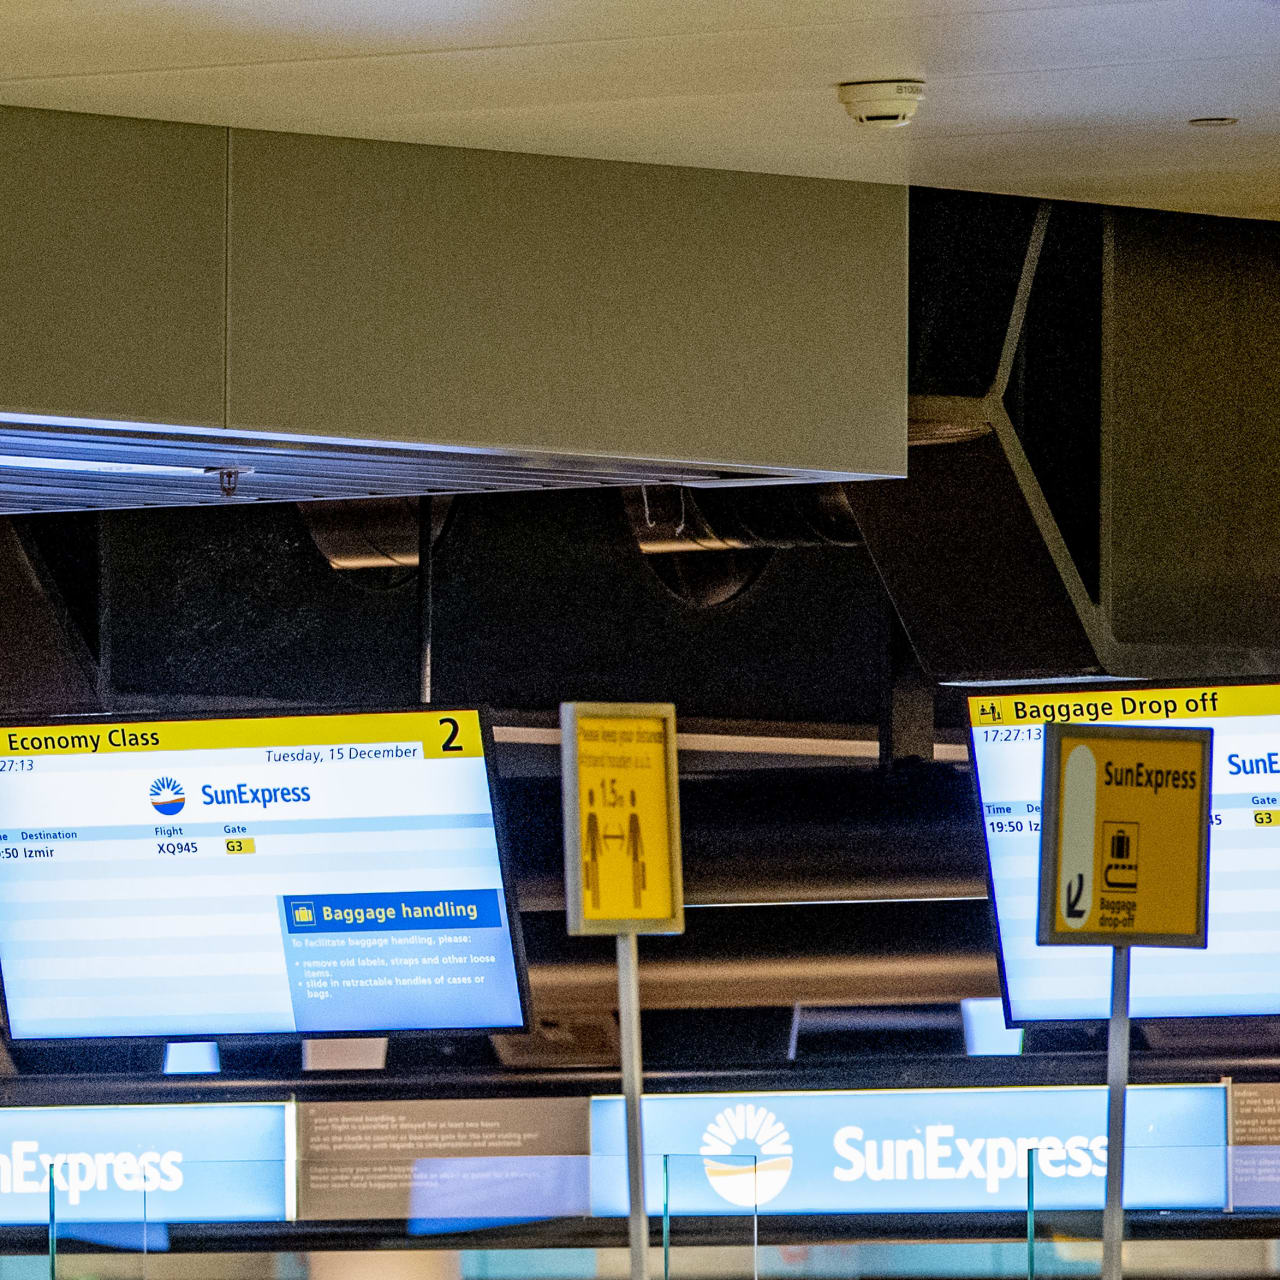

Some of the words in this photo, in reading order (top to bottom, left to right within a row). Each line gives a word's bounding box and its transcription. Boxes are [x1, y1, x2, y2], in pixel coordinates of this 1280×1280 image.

[1014, 700, 1113, 723] Baggage
[1121, 697, 1177, 718] Drop
[1185, 692, 1218, 713] off
[8, 732, 100, 752] Economy
[108, 728, 160, 747] Class
[439, 717, 463, 752] 2
[983, 728, 1042, 743] 17:27:13
[266, 749, 323, 763] Tuesday,
[329, 747, 344, 760] 15
[349, 746, 418, 760] December
[1104, 761, 1197, 795] SunExpress
[201, 783, 311, 809] SunExpress
[1251, 796, 1278, 805] Gate
[985, 804, 1012, 815] Time
[989, 820, 1023, 833] 19:50
[1254, 812, 1273, 825] G3
[21, 830, 77, 841] Destination
[154, 826, 183, 837] Flight
[223, 824, 247, 834] Gate
[23, 847, 54, 858] Izmir
[157, 842, 198, 855] XQ945
[226, 841, 243, 852] G3
[322, 906, 396, 923] Baggage
[401, 902, 478, 919] handling
[1099, 897, 1137, 914] Baggage
[1099, 914, 1135, 929] drop-off
[470, 954, 496, 963] loose
[834, 1125, 1108, 1193] SunExpress
